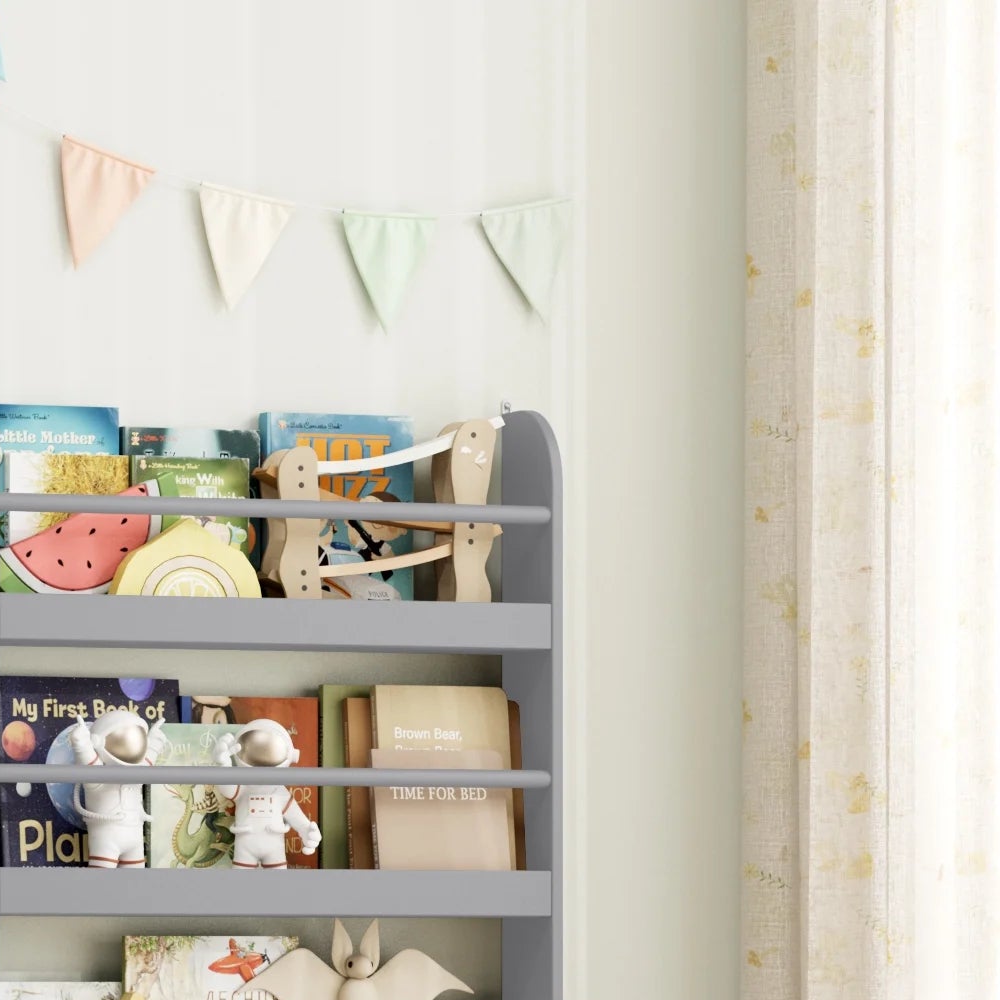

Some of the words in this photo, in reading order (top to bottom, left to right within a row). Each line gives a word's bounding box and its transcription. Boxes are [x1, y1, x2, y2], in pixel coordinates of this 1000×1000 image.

[40, 430, 97, 445] Mother
[12, 698, 38, 722] My
[43, 699, 88, 719] First
[145, 701, 166, 719] of
[394, 726, 431, 741] Brown
[434, 727, 463, 742] Bear,
[389, 786, 425, 801] TIME
[428, 787, 456, 801] FOR
[460, 787, 488, 801] BED
